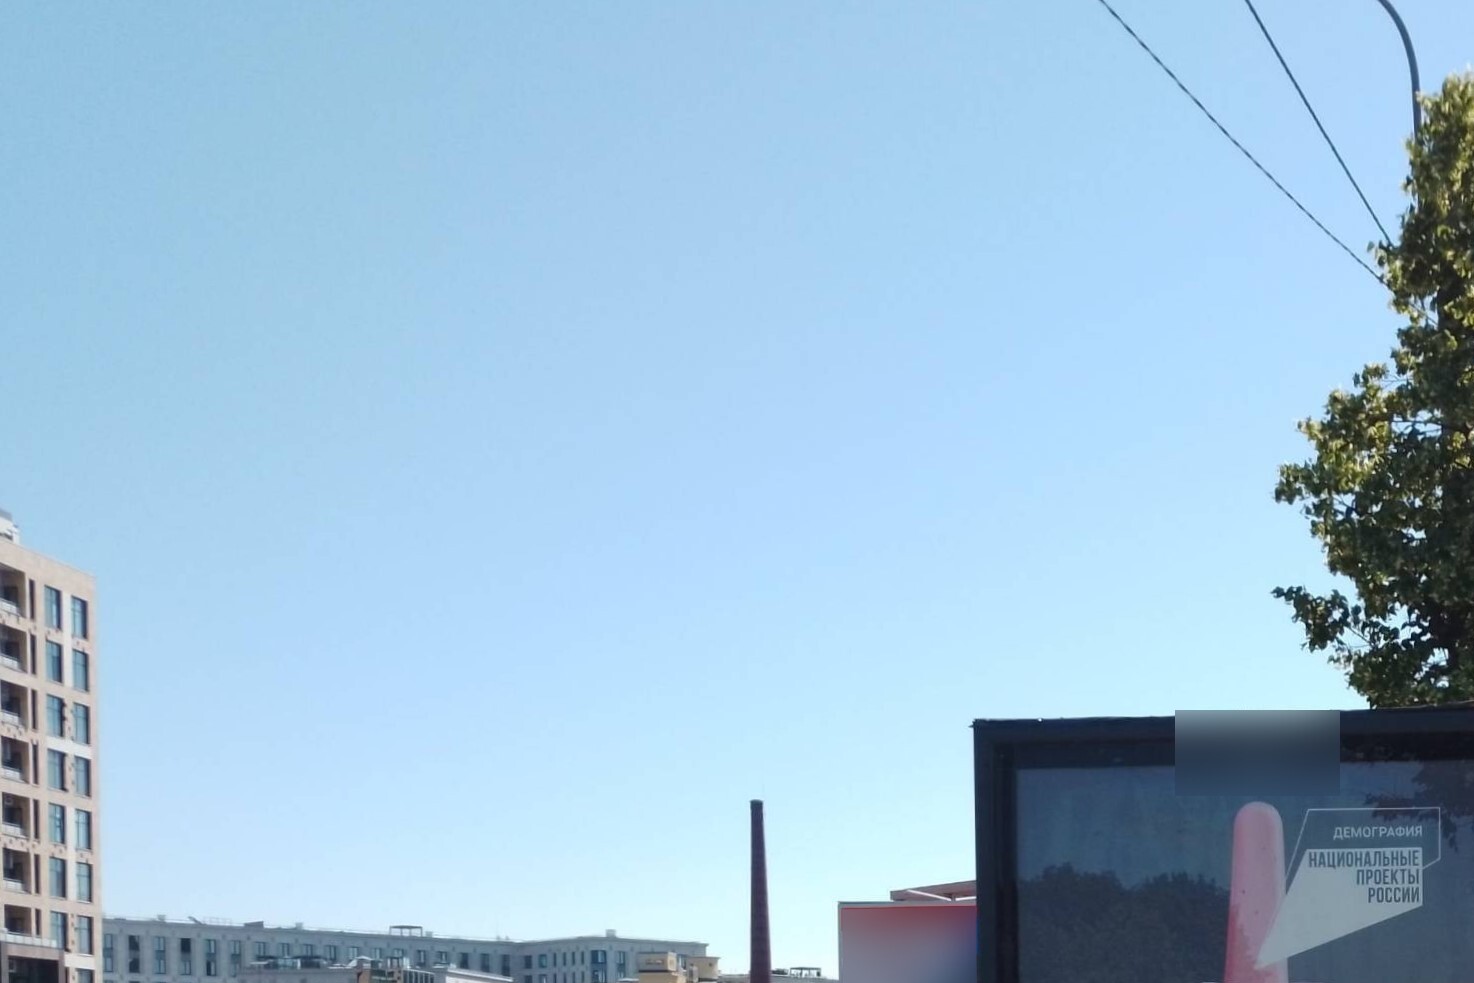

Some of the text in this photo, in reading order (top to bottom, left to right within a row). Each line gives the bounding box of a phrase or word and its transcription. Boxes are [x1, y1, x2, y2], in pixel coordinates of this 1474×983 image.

[1333, 826, 1423, 840] ДЕМОГРАФИЯ
[1308, 850, 1420, 869] НАЦИОНАЛЬНЫЕ
[1356, 869, 1420, 885] ПРОЕКТЫ
[1368, 887, 1420, 904] РОССИИ
